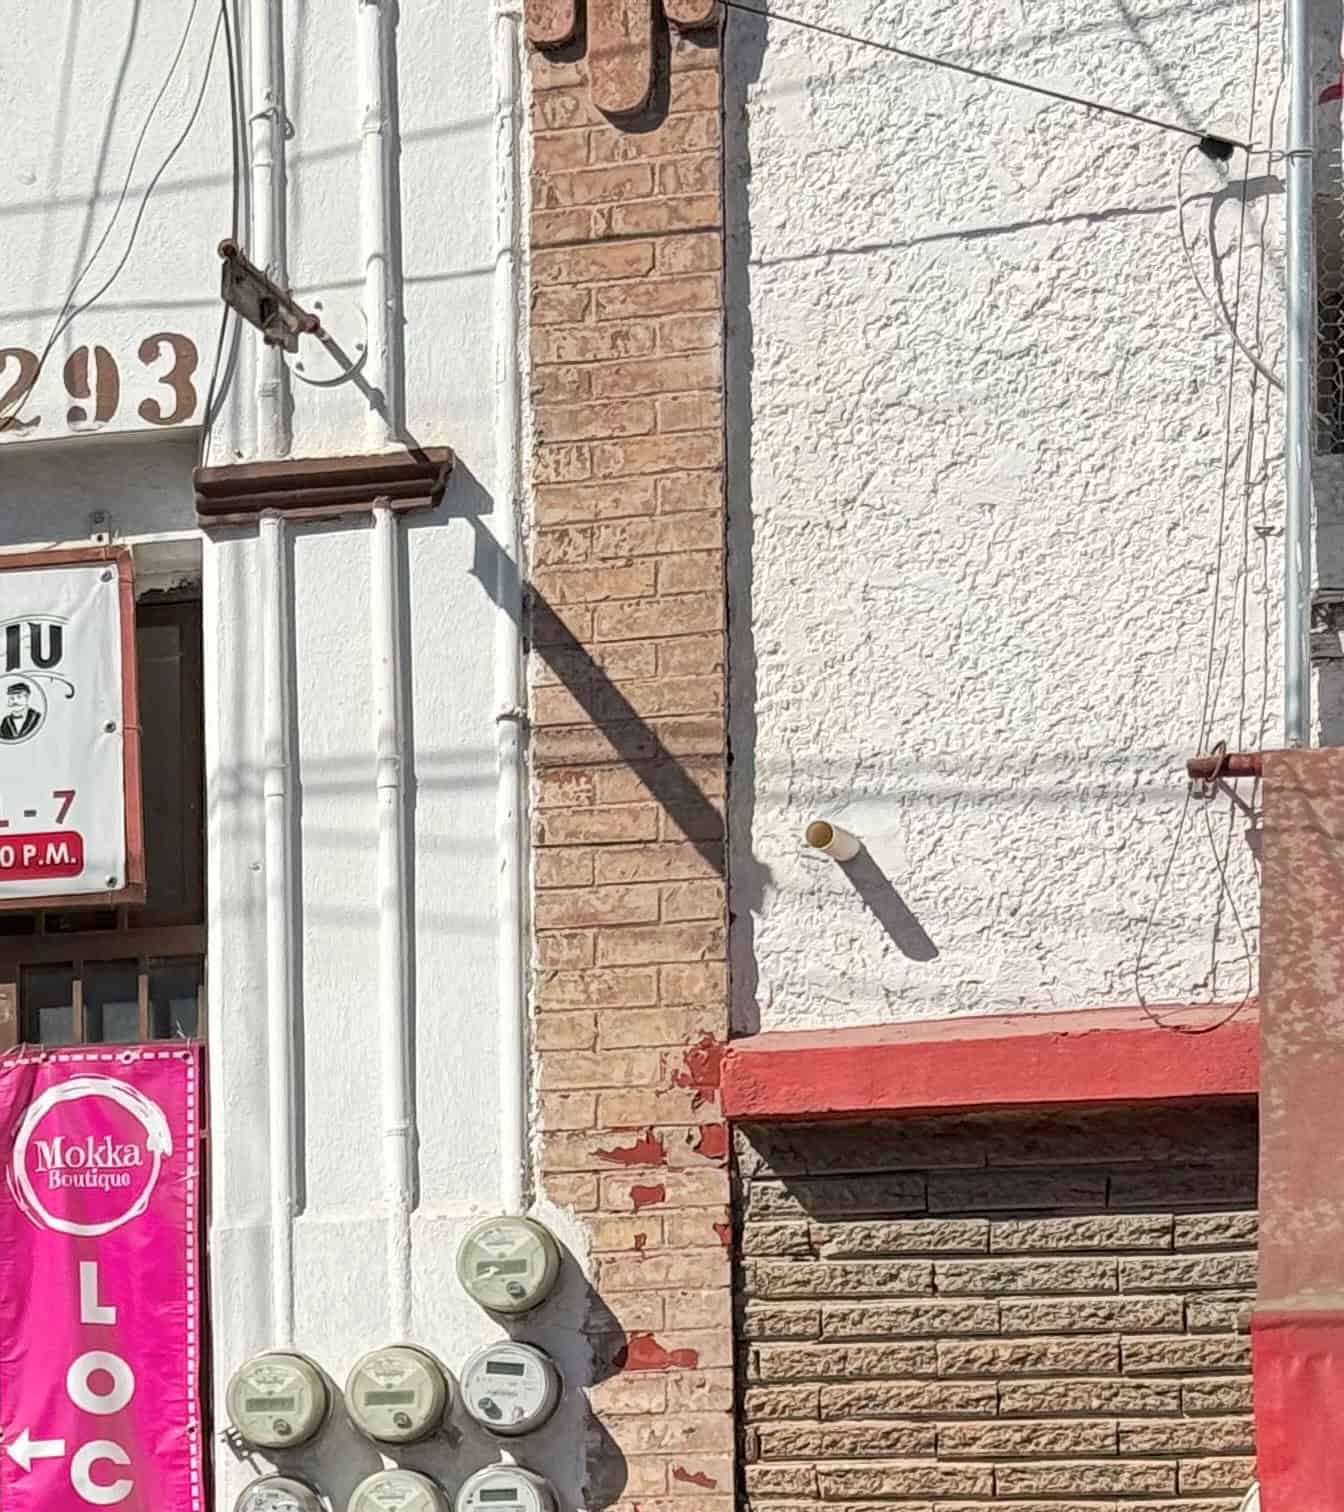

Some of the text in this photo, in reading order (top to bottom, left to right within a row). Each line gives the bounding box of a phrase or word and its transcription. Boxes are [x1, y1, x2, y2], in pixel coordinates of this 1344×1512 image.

[53, 790, 77, 824] 7
[22, 842, 77, 867] P.M.
[34, 1136, 143, 1173] Mokka
[49, 1168, 131, 1191] Boutique
